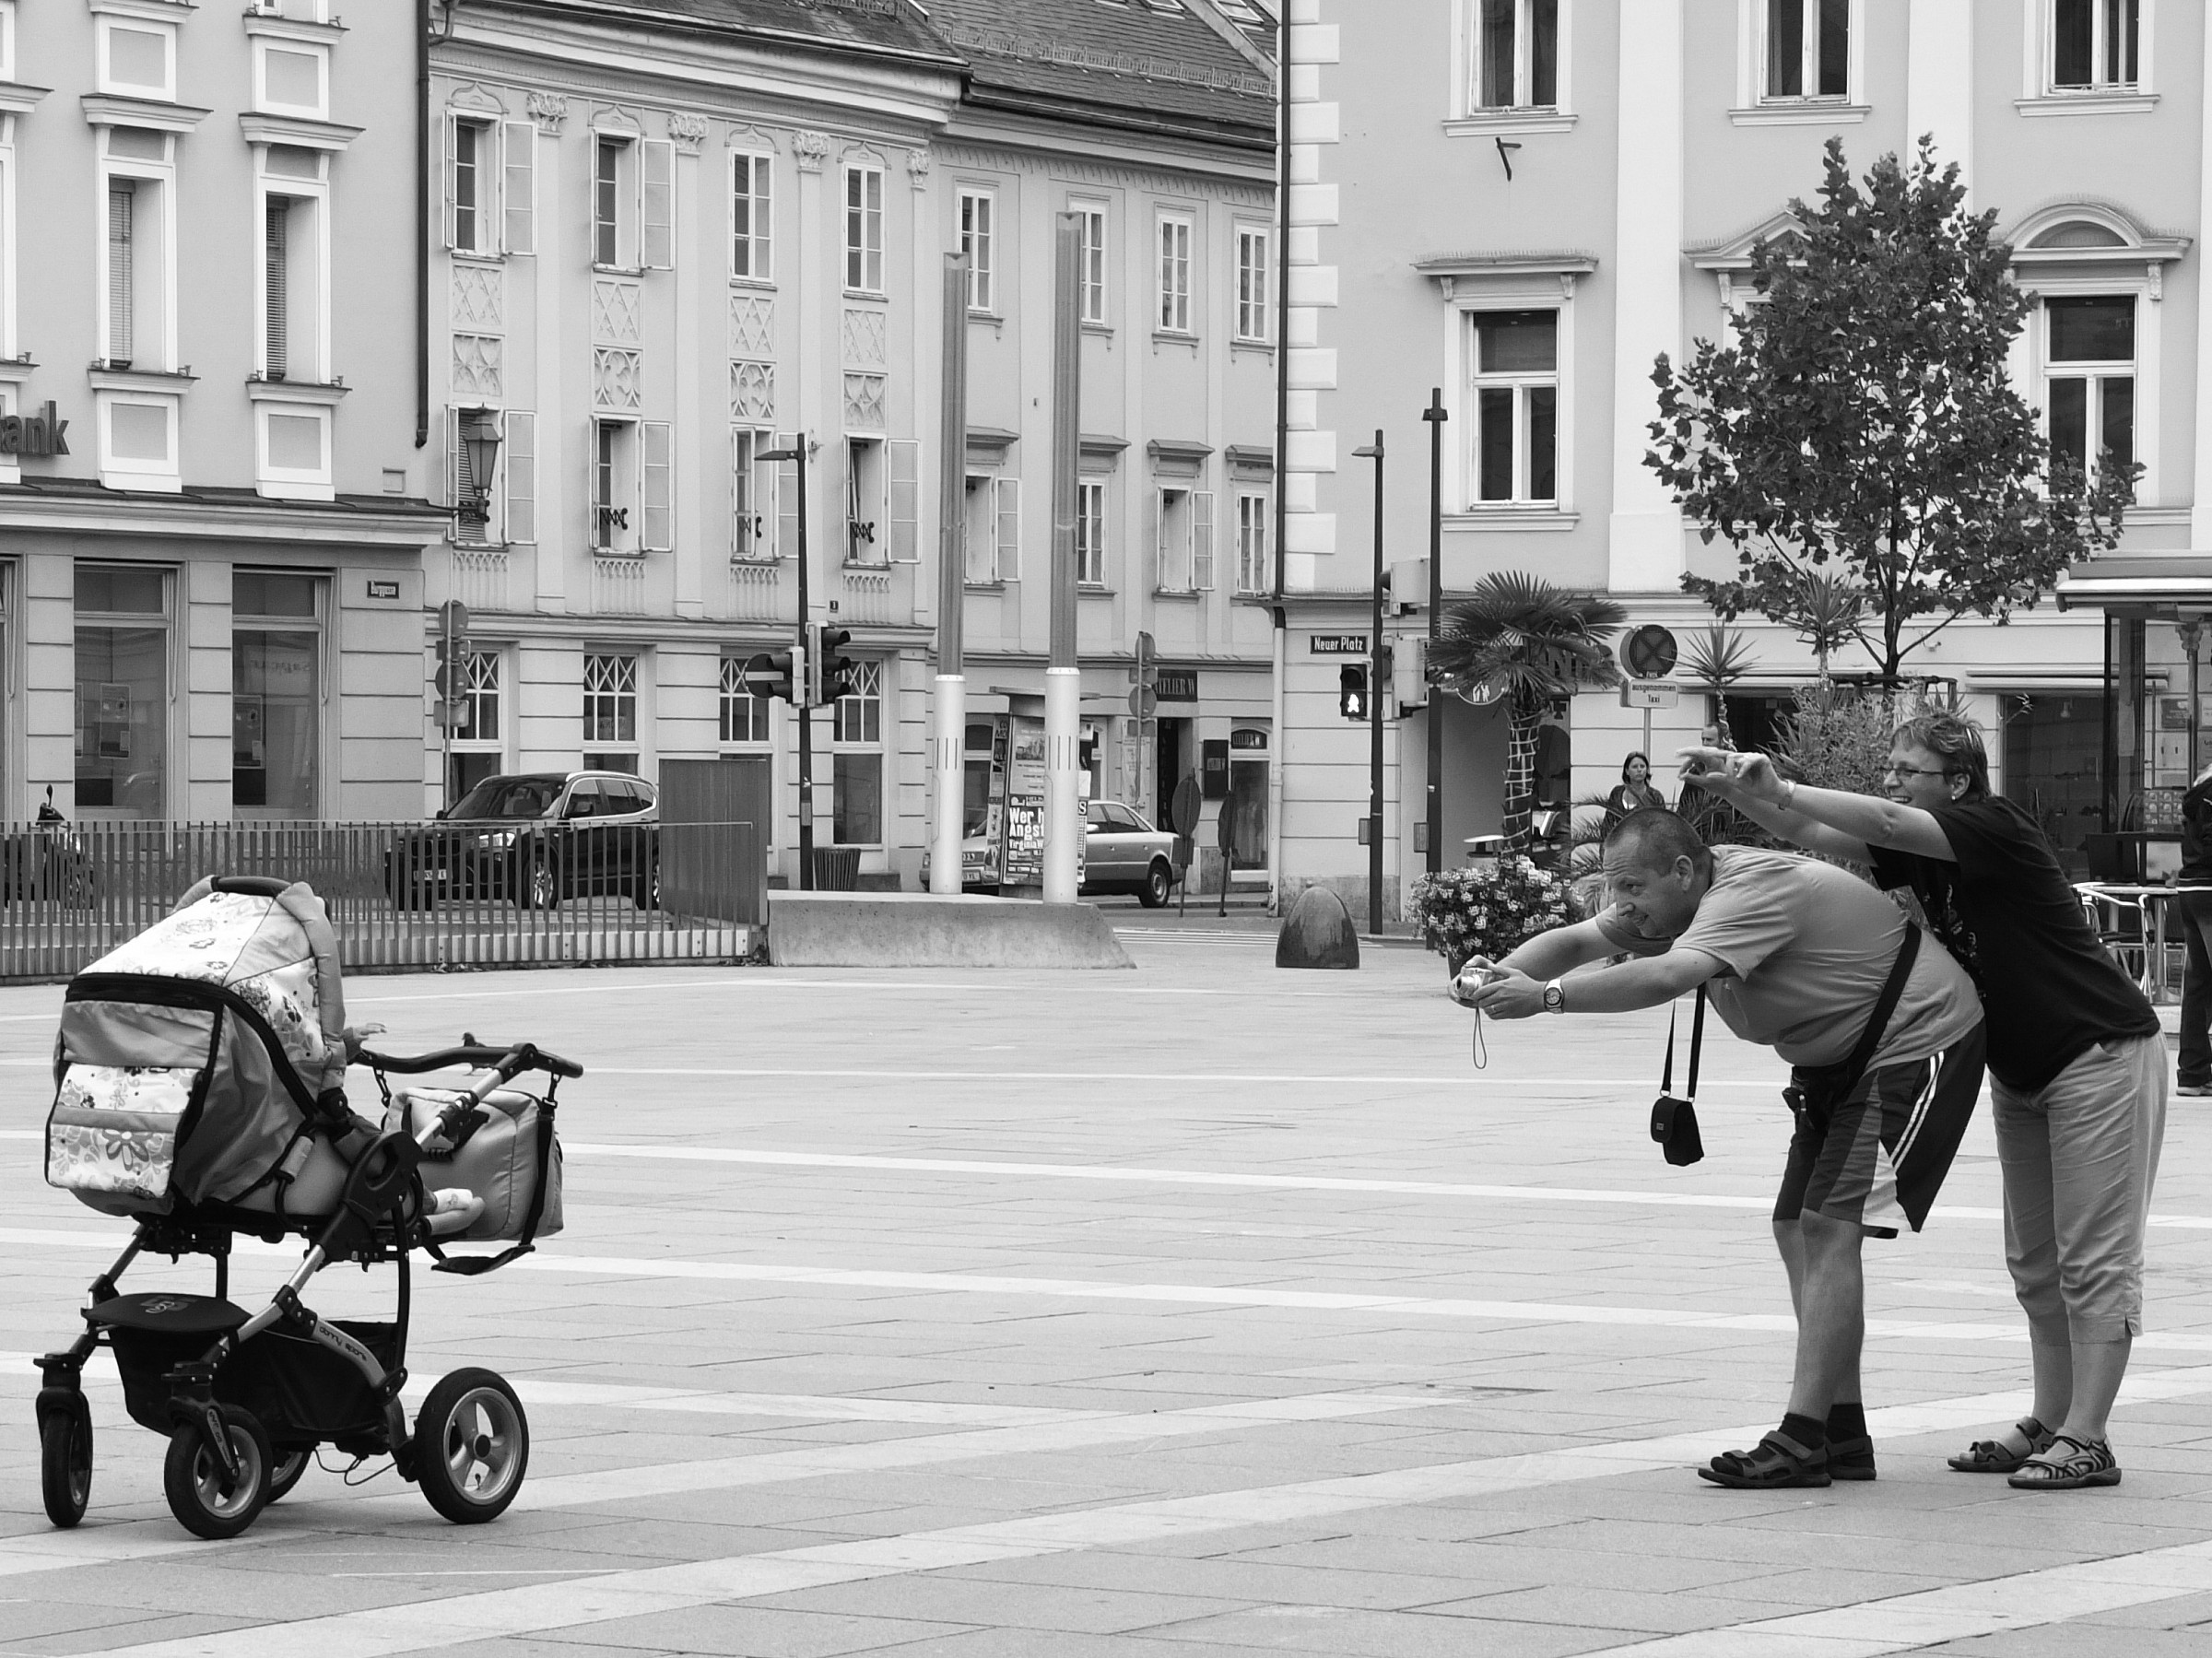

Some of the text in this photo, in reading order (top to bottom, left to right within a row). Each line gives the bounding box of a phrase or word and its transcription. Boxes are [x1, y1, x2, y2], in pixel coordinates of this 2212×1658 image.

[1314, 636, 1363, 651] Neuer Platz
[1648, 694, 1660, 703] Taxi
[1009, 807, 1034, 824] Wer
